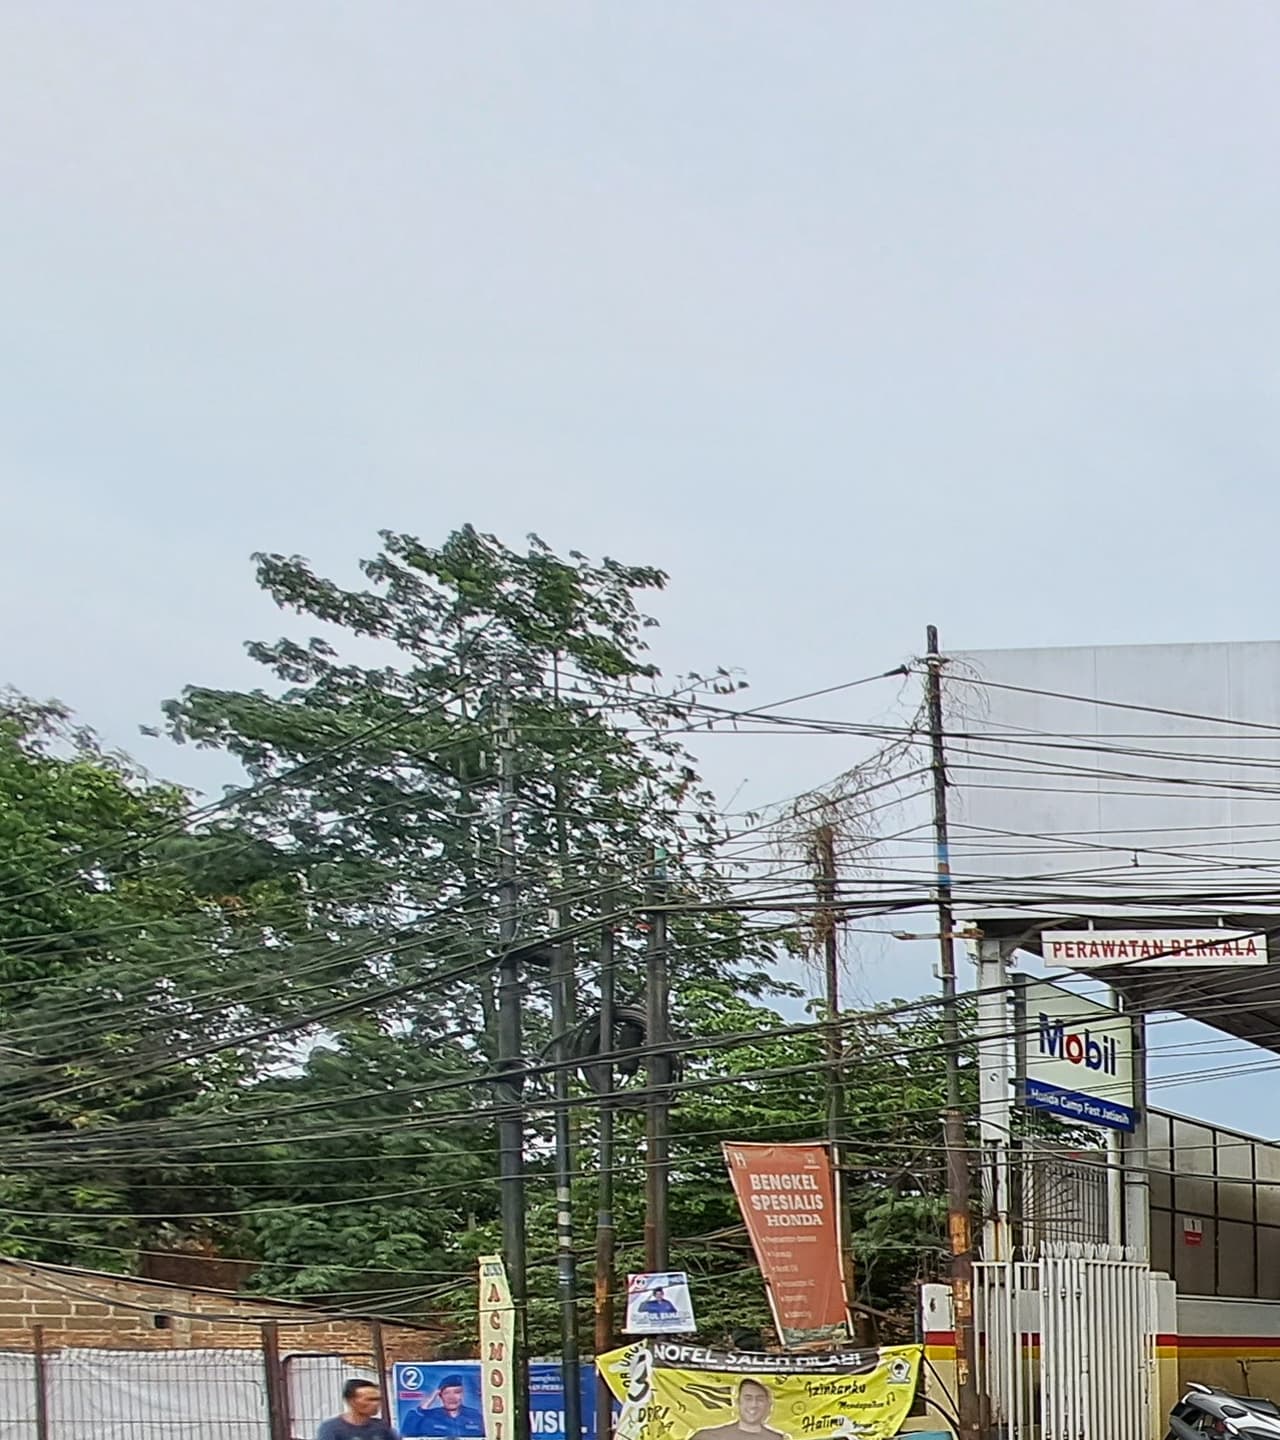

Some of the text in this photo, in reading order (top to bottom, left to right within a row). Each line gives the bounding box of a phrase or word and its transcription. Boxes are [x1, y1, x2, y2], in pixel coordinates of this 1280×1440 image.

[1053, 937, 1258, 959] PERAWATAN BERKALA
[1038, 1011, 1117, 1076] Mobil
[749, 1173, 818, 1191] BENGKEL
[750, 1193, 825, 1212] SPESIALIS
[766, 1213, 824, 1227] HONDA
[653, 1344, 718, 1364] NOFEL
[406, 1370, 418, 1387] 2
